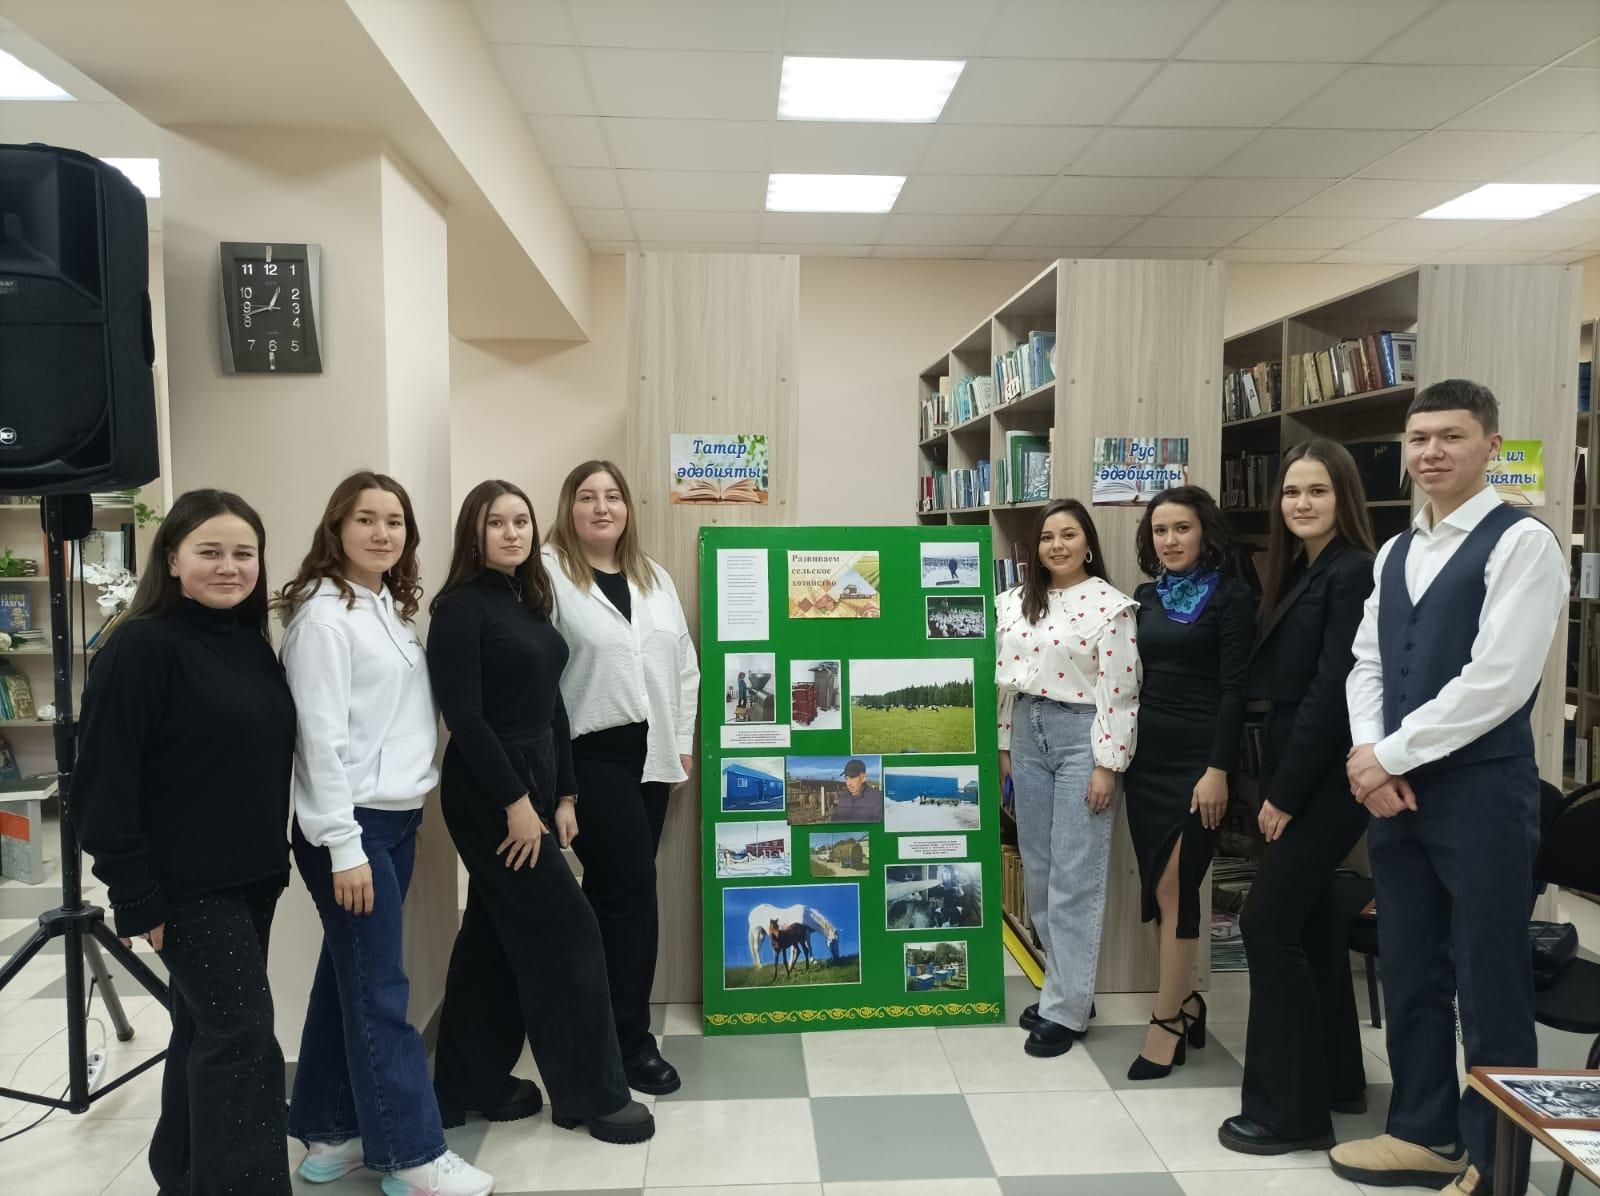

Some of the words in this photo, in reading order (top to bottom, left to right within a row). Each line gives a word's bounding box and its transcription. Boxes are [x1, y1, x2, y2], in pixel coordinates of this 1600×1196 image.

[241, 264, 253, 275] 11
[264, 264, 278, 276] 12
[289, 264, 296, 276] 1
[240, 287, 252, 299] 10
[291, 288, 300, 300] 2
[242, 301, 251, 313] 9
[292, 303, 300, 314] 3
[243, 316, 252, 328] 8
[292, 317, 301, 328] 4
[247, 339, 255, 351] 7
[268, 339, 277, 352] 6
[290, 340, 299, 352] 5
[693, 439, 747, 459] Татар
[1129, 443, 1156, 461] Рус
[677, 462, 761, 479] әдәбияты
[1100, 464, 1182, 480] әдәбияты
[791, 554, 840, 563] Развиваем
[791, 567, 832, 575] сельское
[791, 579, 837, 587] хозяйство
